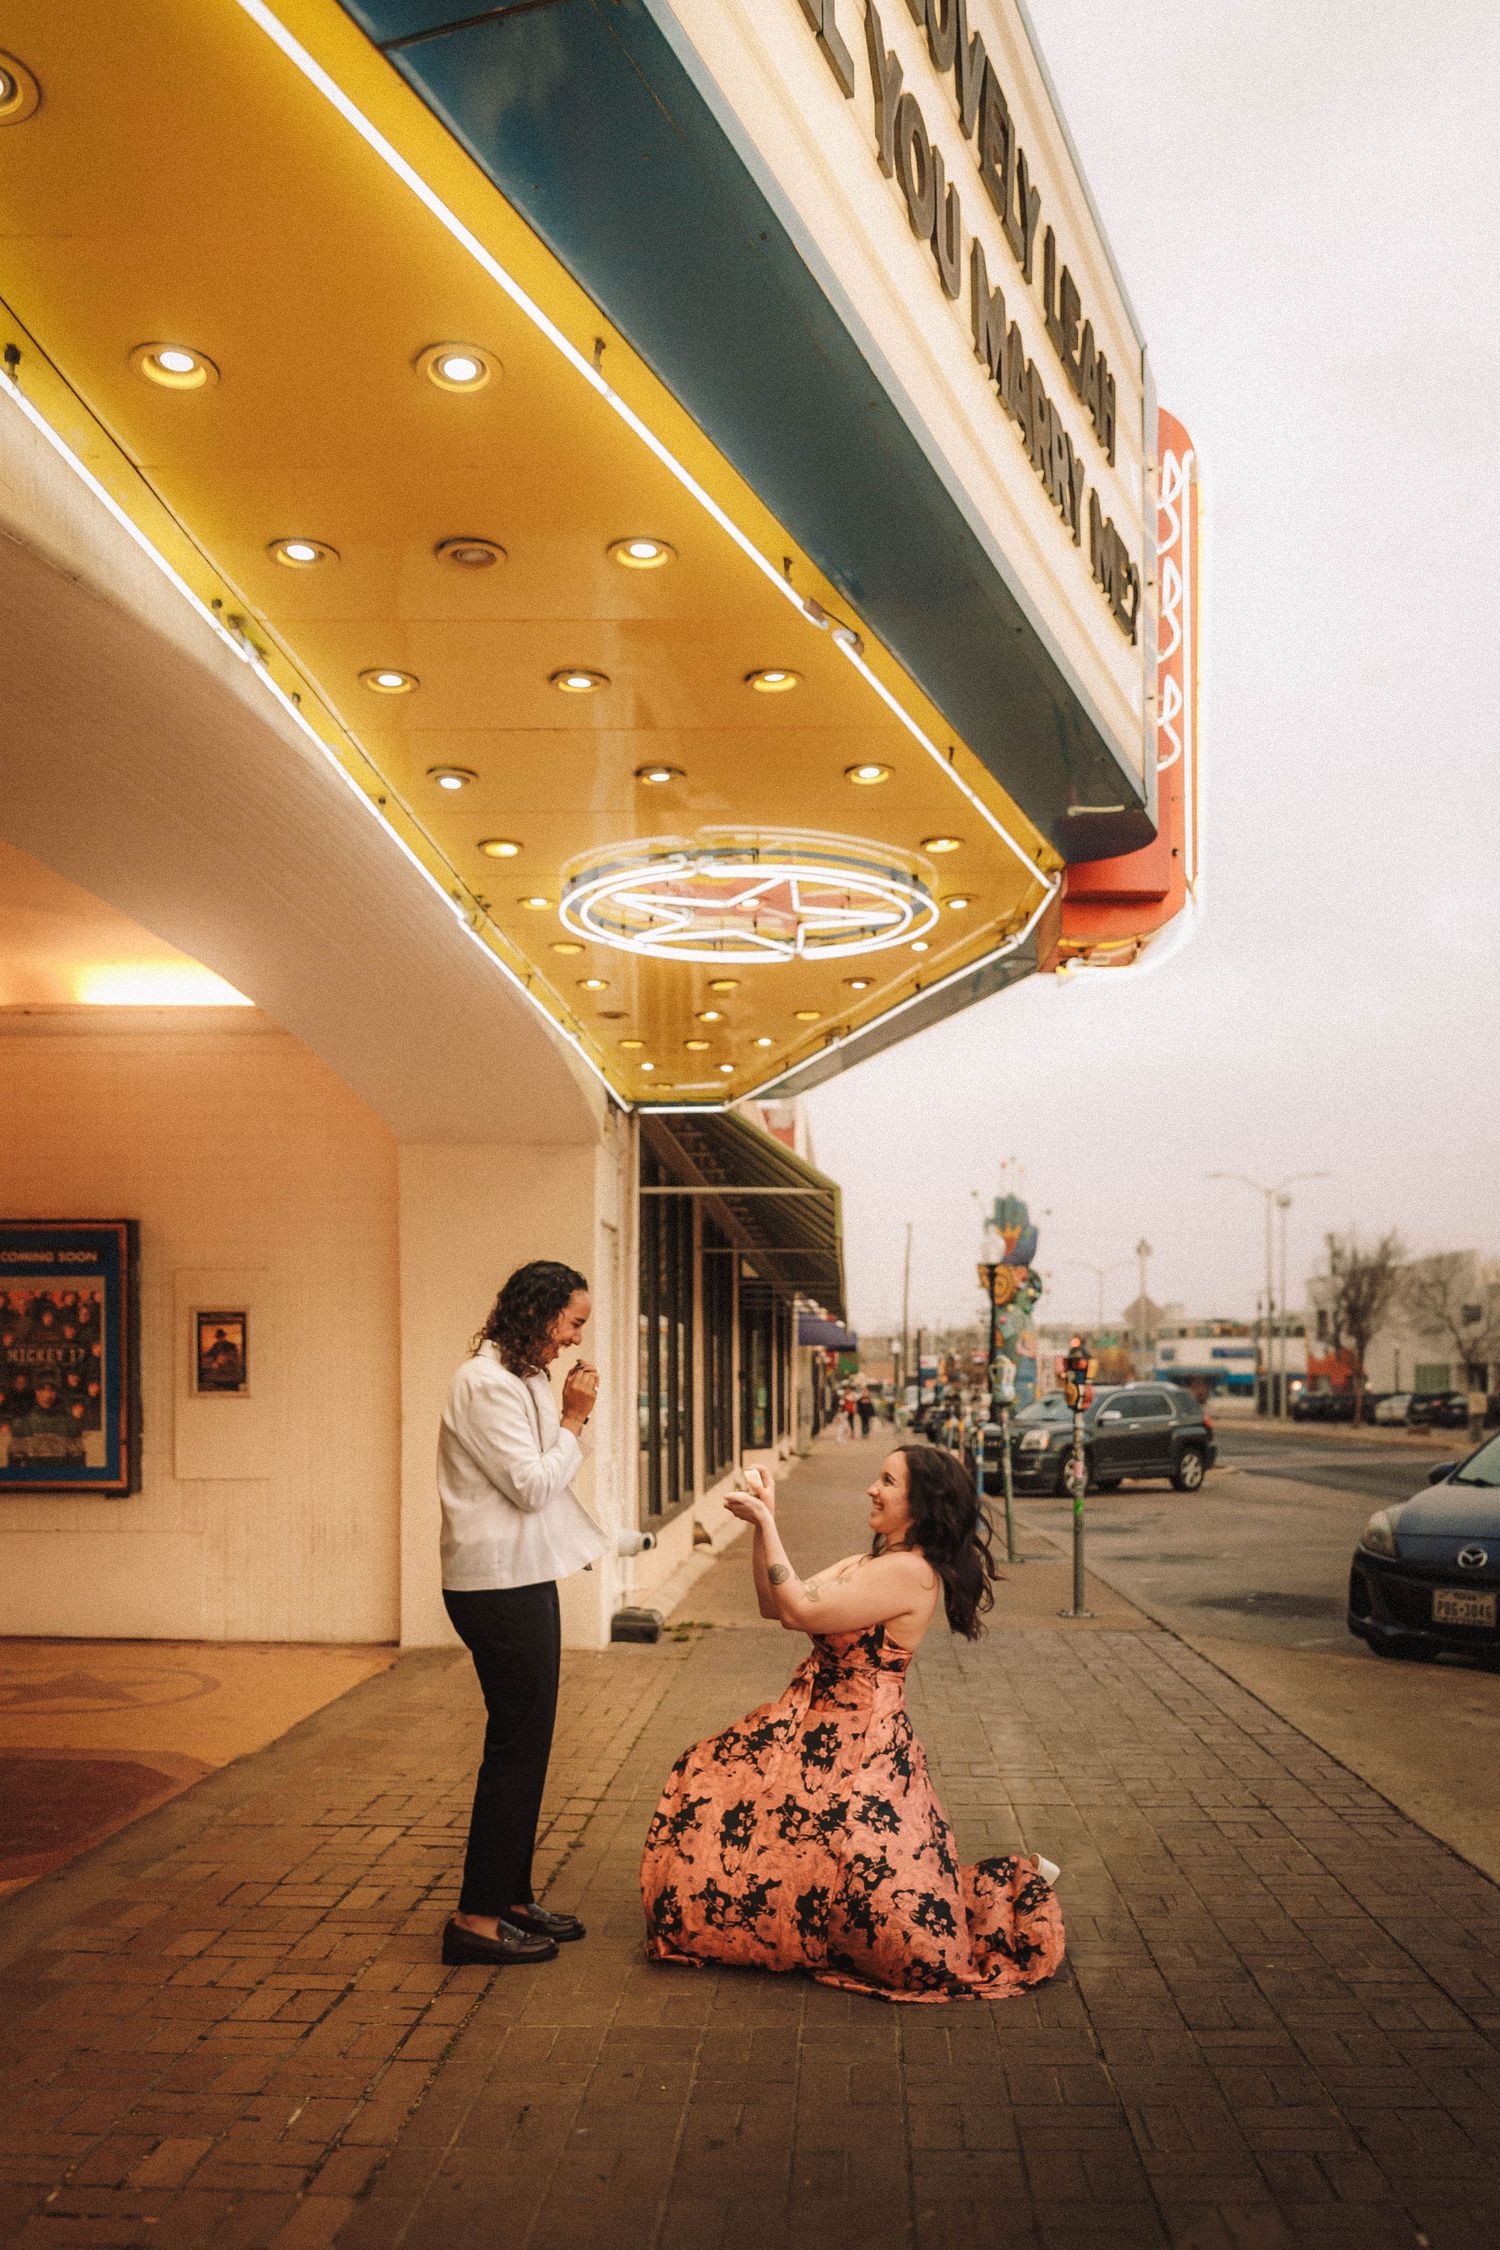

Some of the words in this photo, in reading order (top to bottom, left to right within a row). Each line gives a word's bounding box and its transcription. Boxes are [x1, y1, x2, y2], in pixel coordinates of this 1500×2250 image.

[864, 0, 962, 300] YOU
[970, 236, 1086, 548] MARRY
[1089, 487, 1141, 646] ME?
[1043, 225, 1116, 468] LEAH
